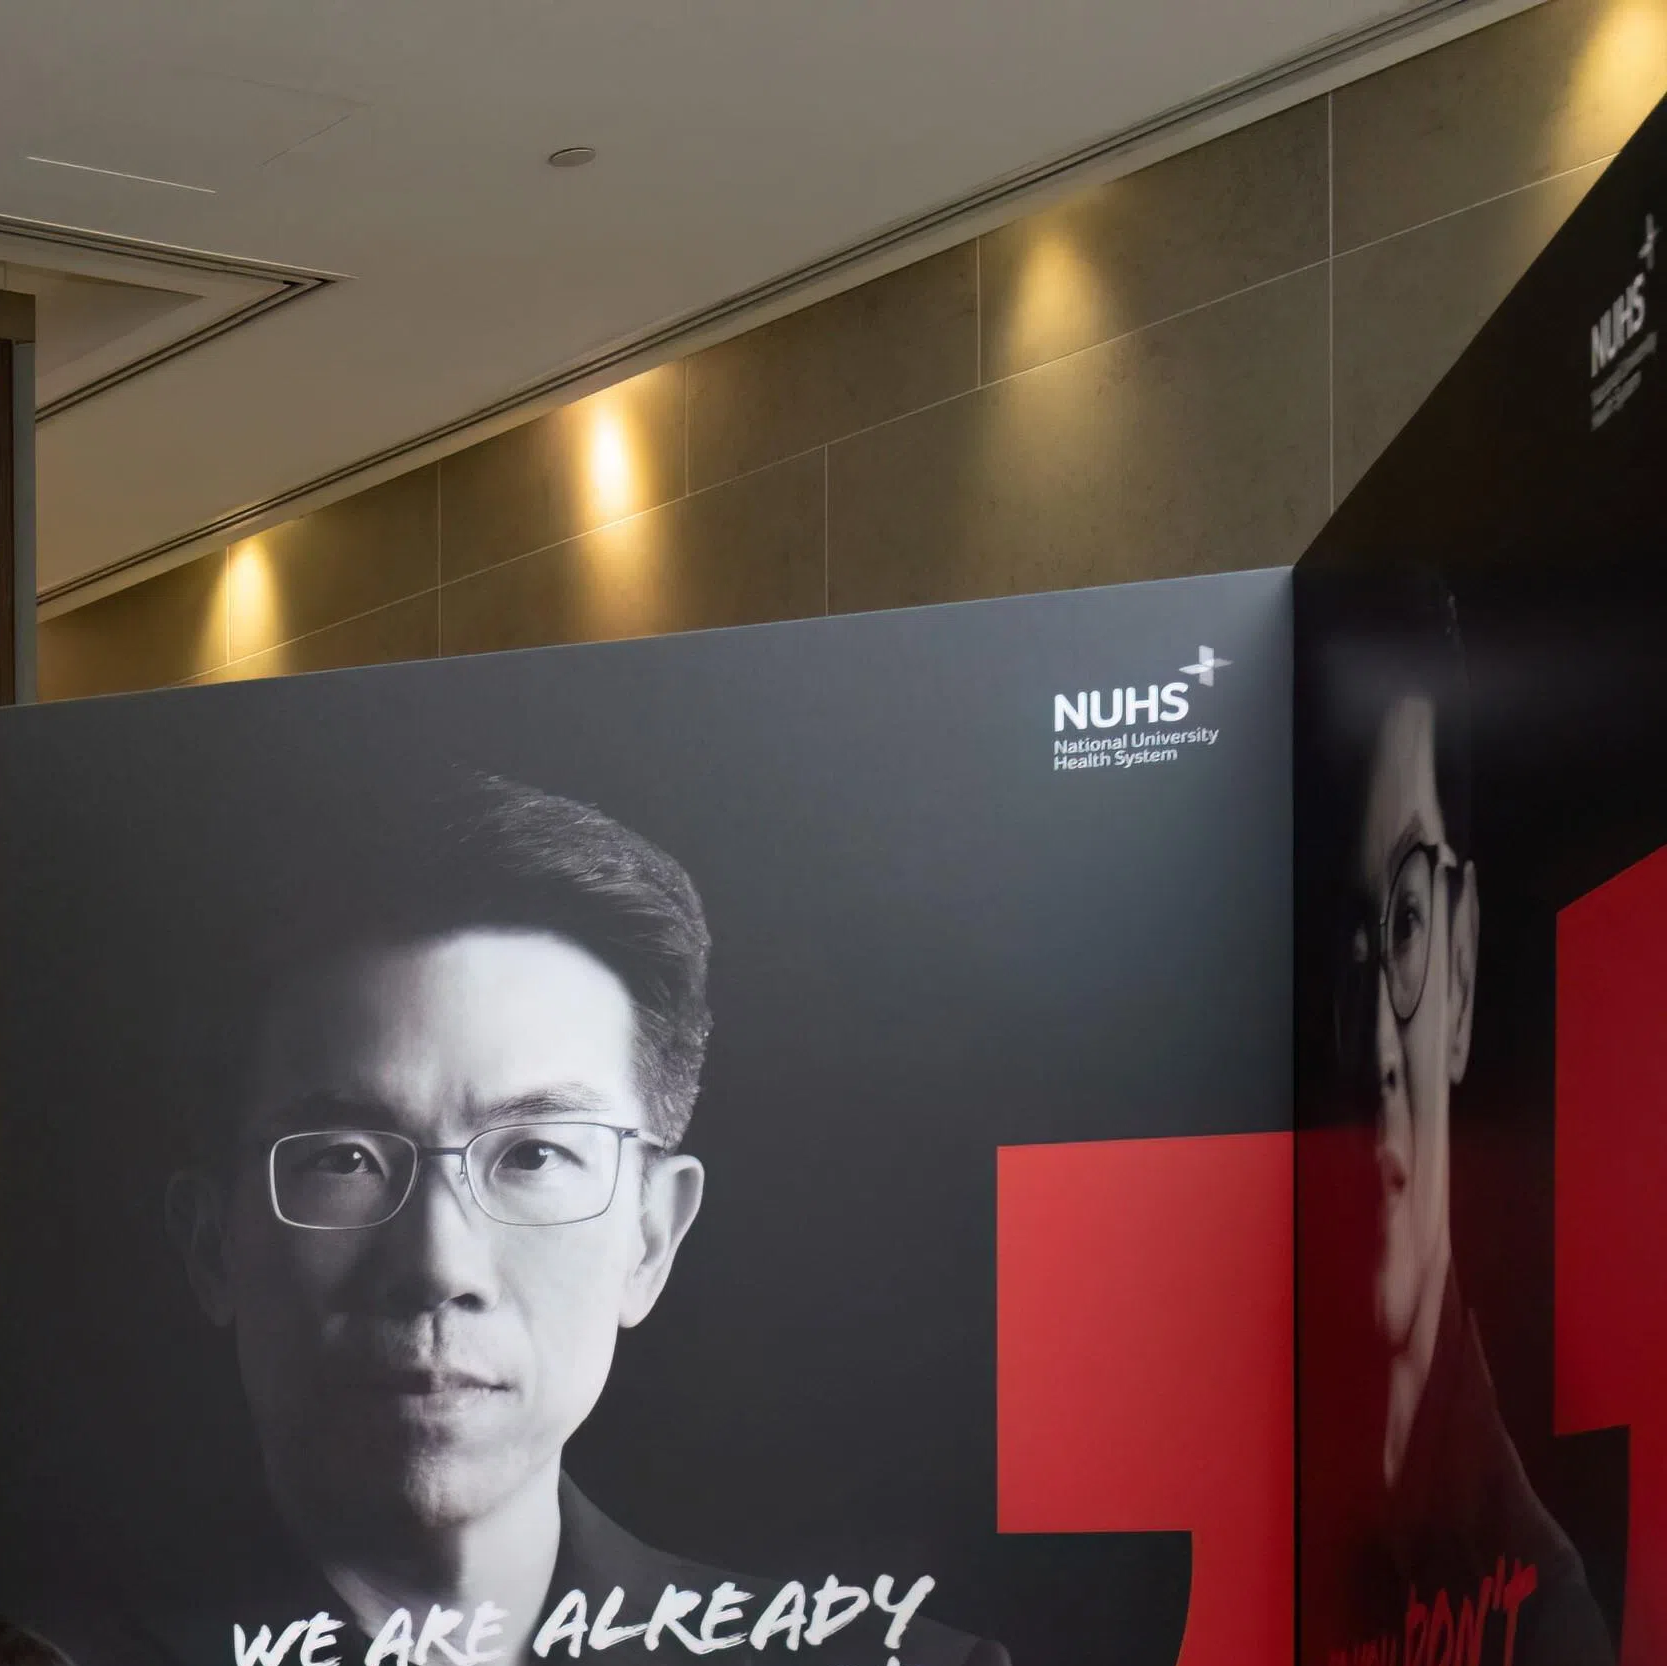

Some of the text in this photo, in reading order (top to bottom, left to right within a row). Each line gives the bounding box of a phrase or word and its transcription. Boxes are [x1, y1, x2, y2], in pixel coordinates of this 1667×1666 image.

[1054, 682, 1189, 732] NUHS
[1054, 727, 1219, 755] National University
[1054, 747, 1177, 771] Health System
[533, 1575, 937, 1659] ALREADY
